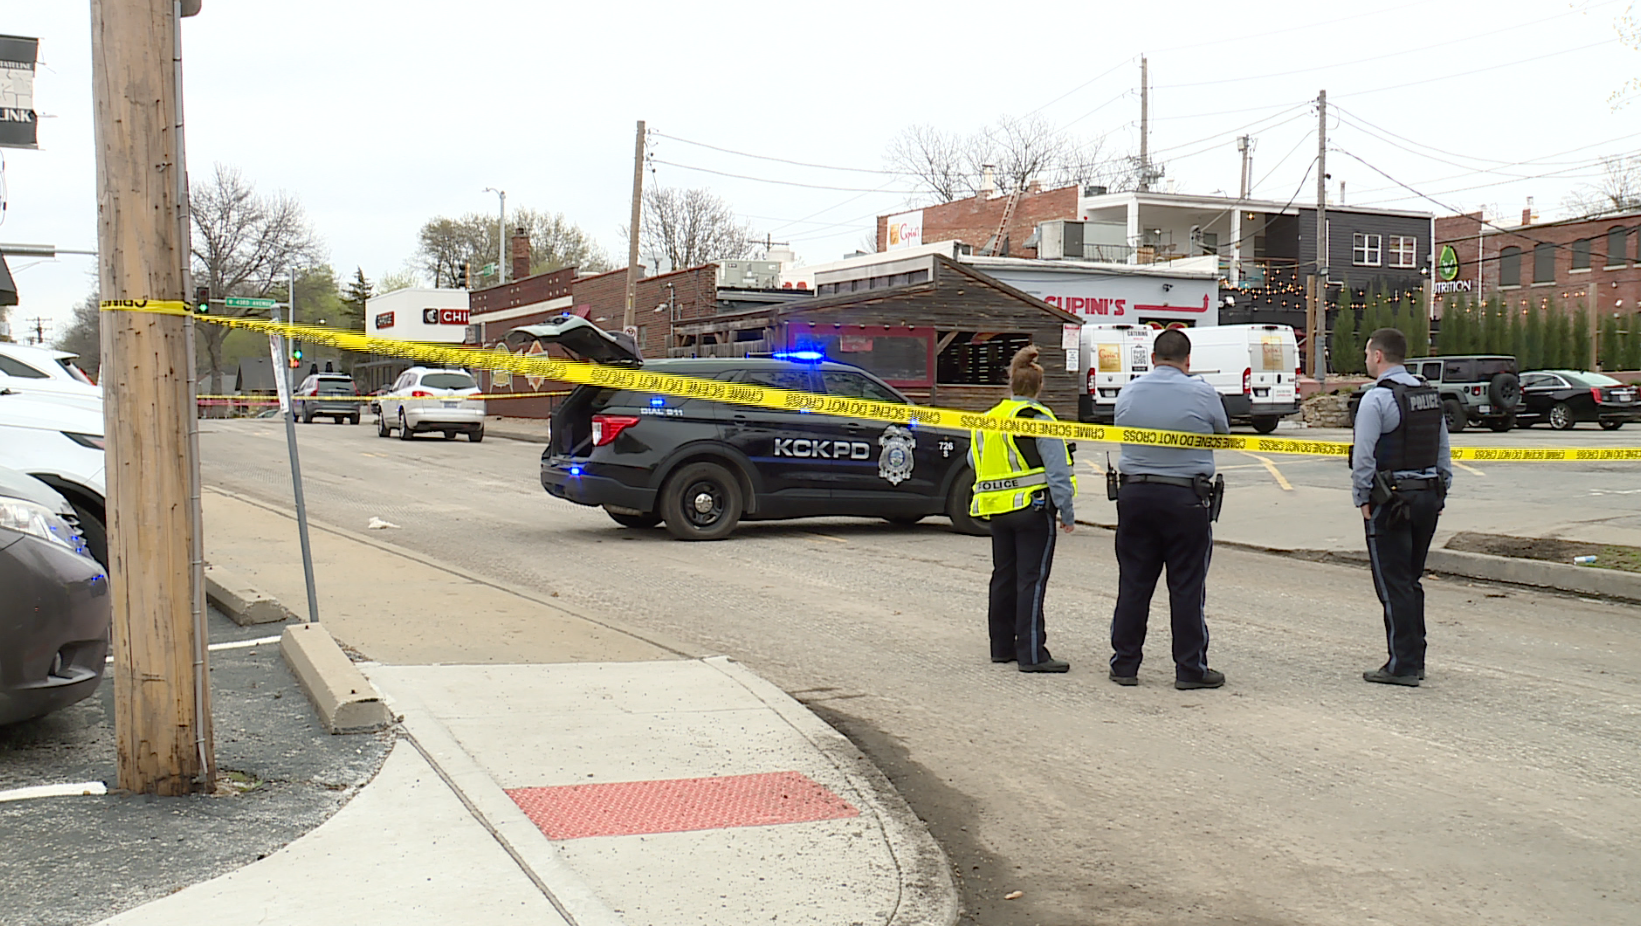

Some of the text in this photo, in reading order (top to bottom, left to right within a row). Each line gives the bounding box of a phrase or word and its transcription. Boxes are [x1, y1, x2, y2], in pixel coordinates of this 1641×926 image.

[827, 399, 850, 413] NOT
[850, 401, 868, 416] DO
[1410, 394, 1439, 411] POLICE
[869, 403, 905, 420] SCENE
[961, 414, 1105, 440] CRIME SCENE DO NOT CROSS
[1123, 429, 1157, 444] CROSS
[1159, 433, 1178, 445] NOT
[1179, 434, 1195, 447] DO
[1194, 435, 1222, 449] SCENE
[774, 438, 870, 459] KCKPD
[939, 442, 954, 451] 726
